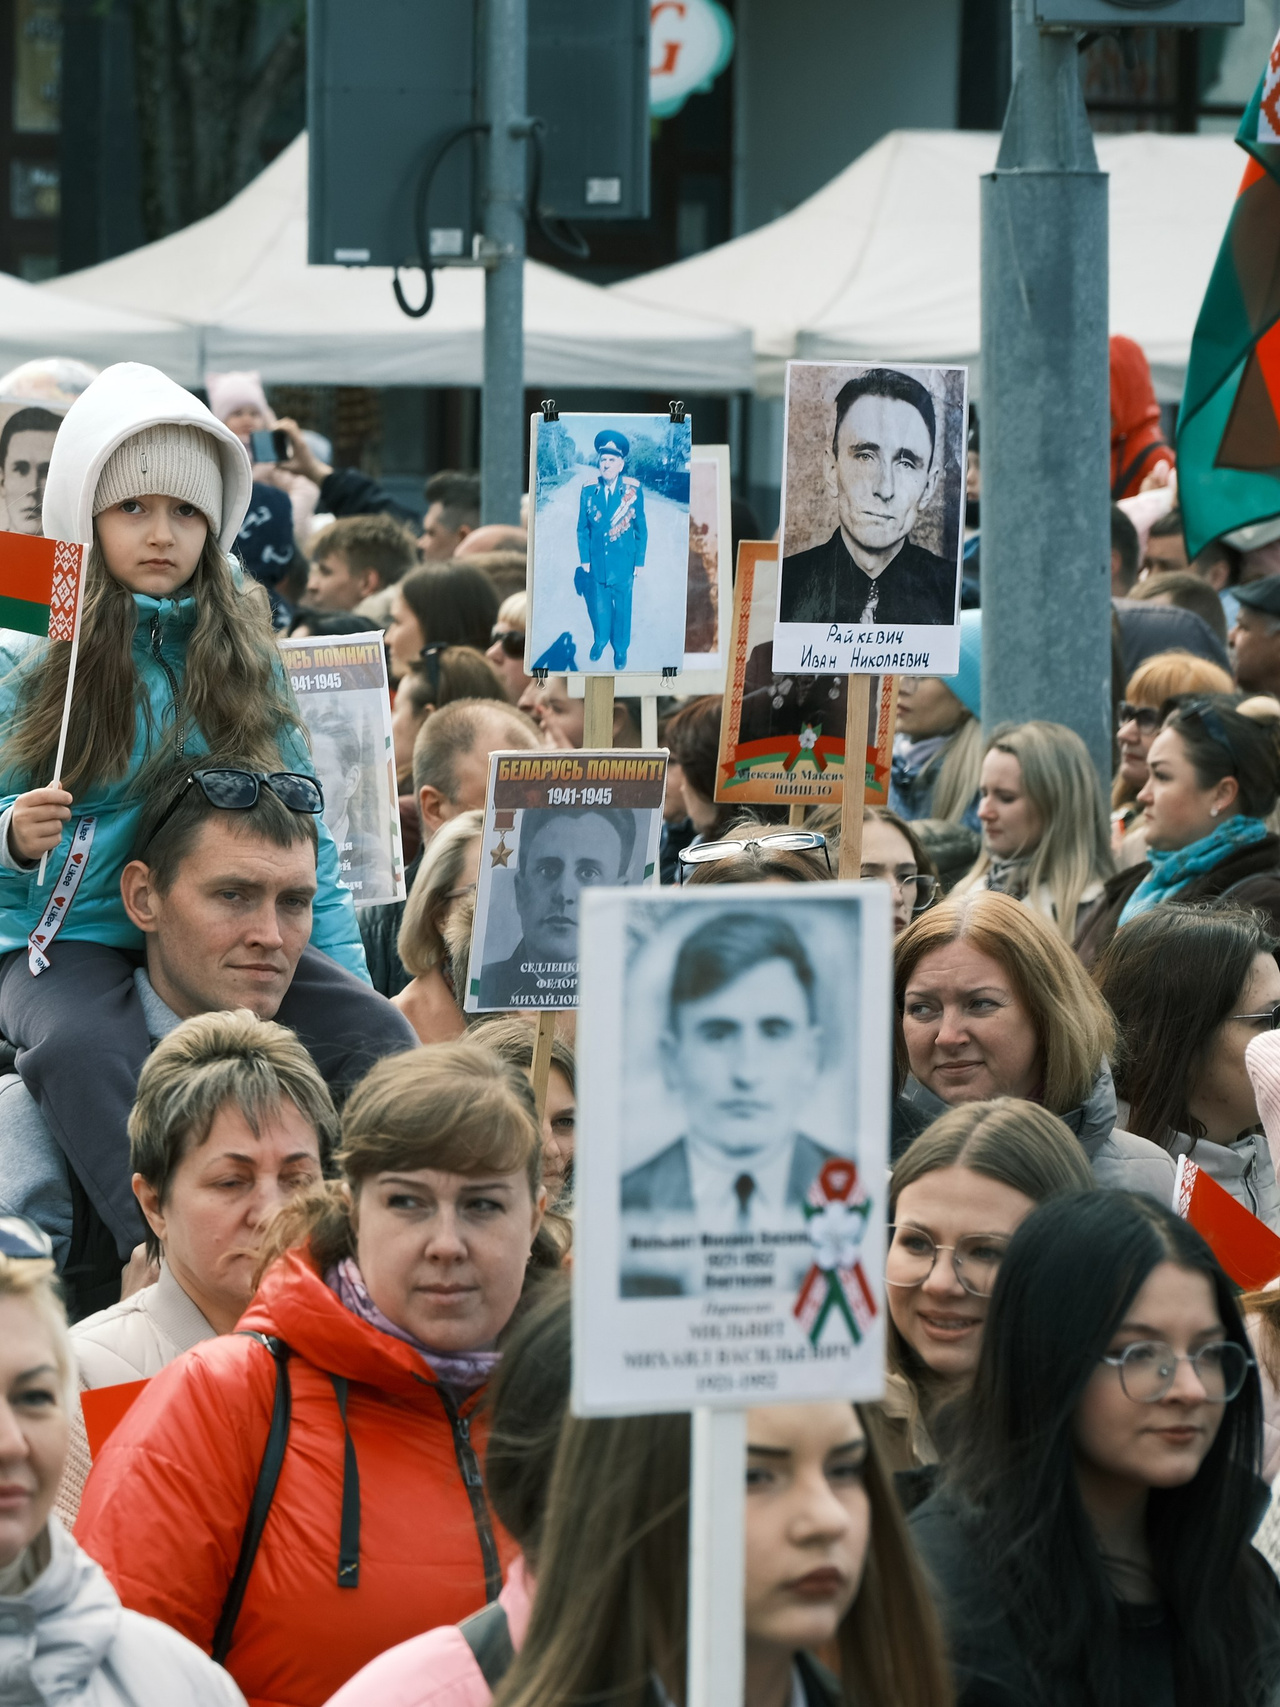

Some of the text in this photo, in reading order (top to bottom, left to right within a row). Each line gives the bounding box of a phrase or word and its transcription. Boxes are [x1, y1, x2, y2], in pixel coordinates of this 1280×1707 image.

[313, 645, 380, 668] ПОМНИТ!
[290, 672, 342, 692] 941-1945
[498, 759, 665, 782] БЕЛАРУСЬ ПОМНИТ!
[736, 768, 797, 783] Александр
[547, 787, 613, 805] 1941-1945
[774, 784, 832, 797] ШИШЛО
[62, 863, 79, 887] Likee
[44, 905, 62, 928] Likee
[536, 978, 578, 990] ФЕДОР
[509, 992, 580, 1006] МИХАЙЛОВ
